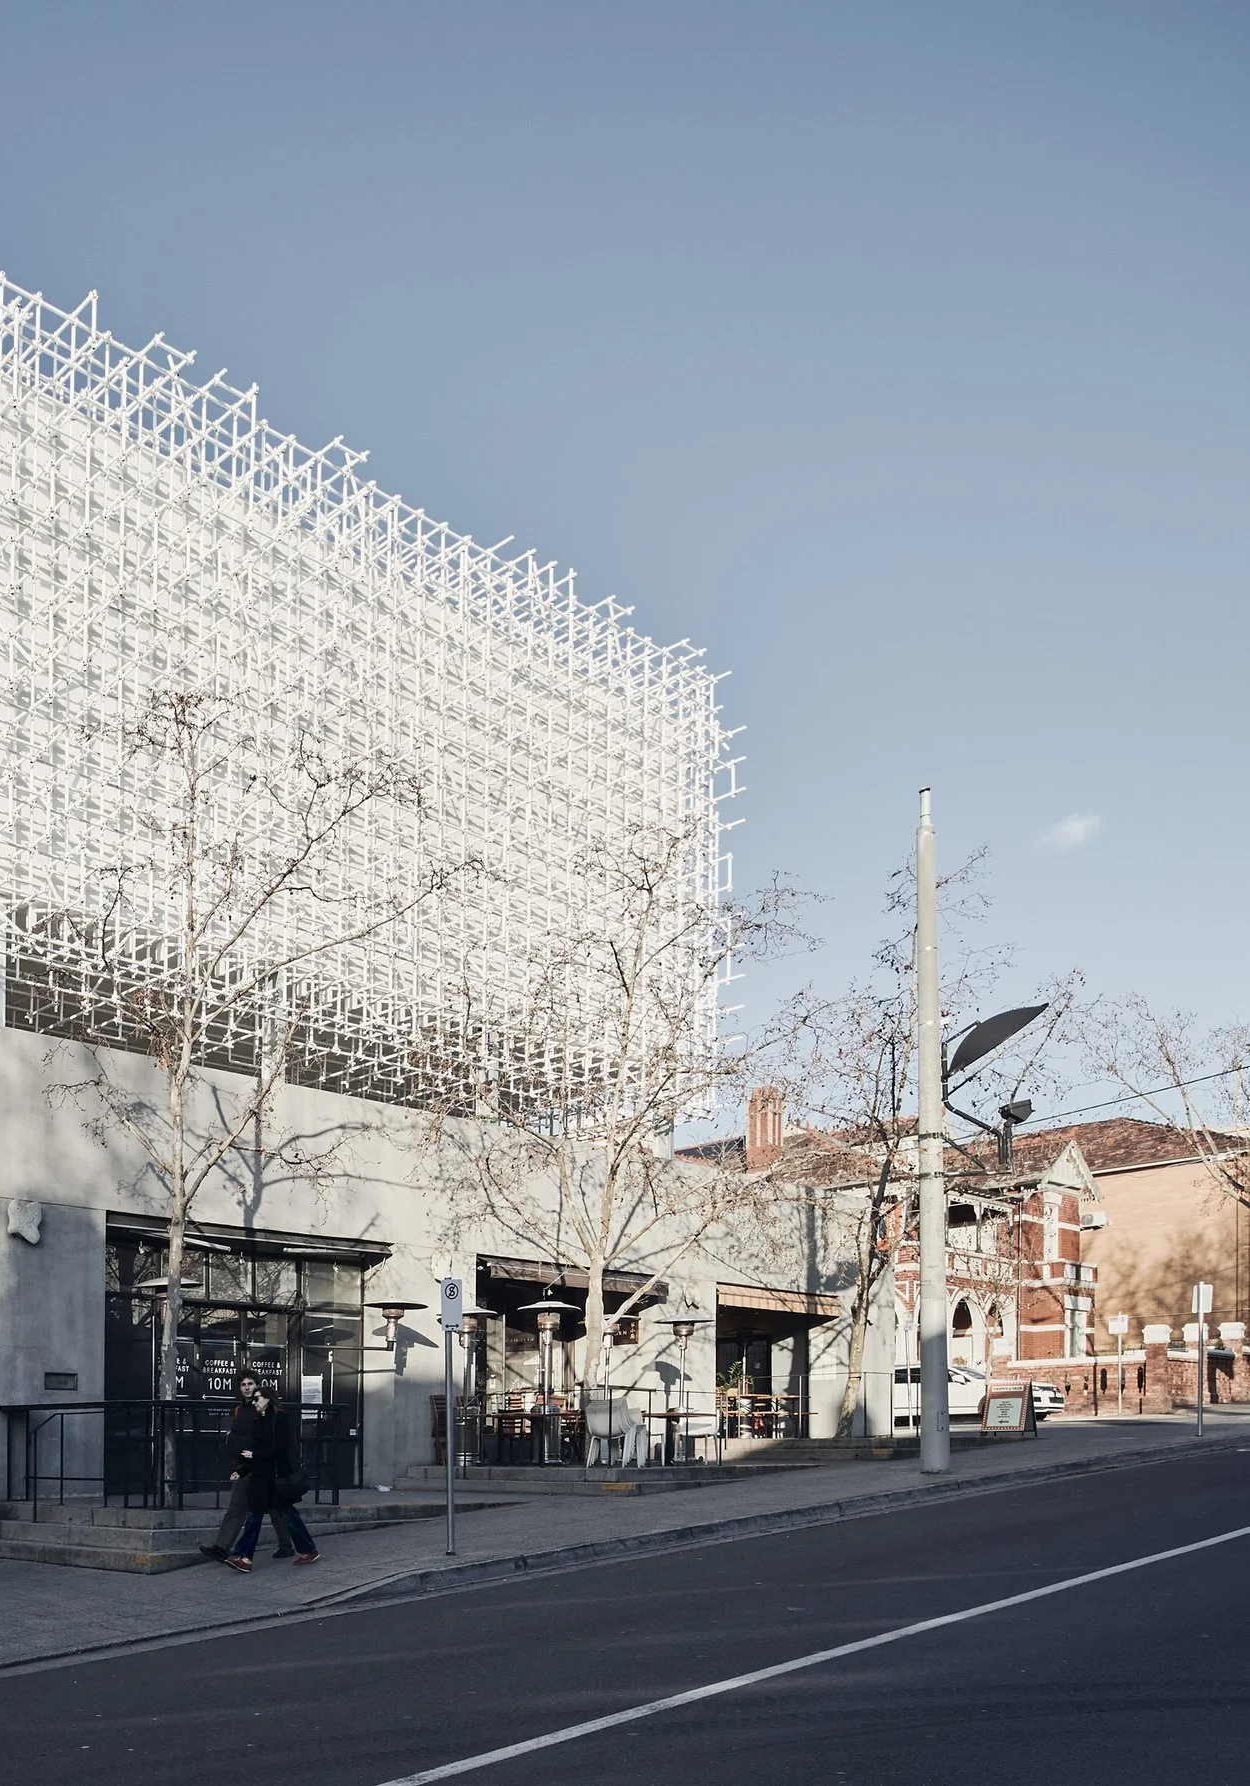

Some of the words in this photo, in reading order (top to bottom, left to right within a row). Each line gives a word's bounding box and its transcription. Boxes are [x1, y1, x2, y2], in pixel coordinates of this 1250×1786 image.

[204, 1359, 229, 1367] COFFEE
[252, 1361, 275, 1369] COFFEE
[202, 1366, 237, 1375] BREAKFAST
[251, 1368, 283, 1376] EAKFAST
[207, 1377, 232, 1391] 10M
